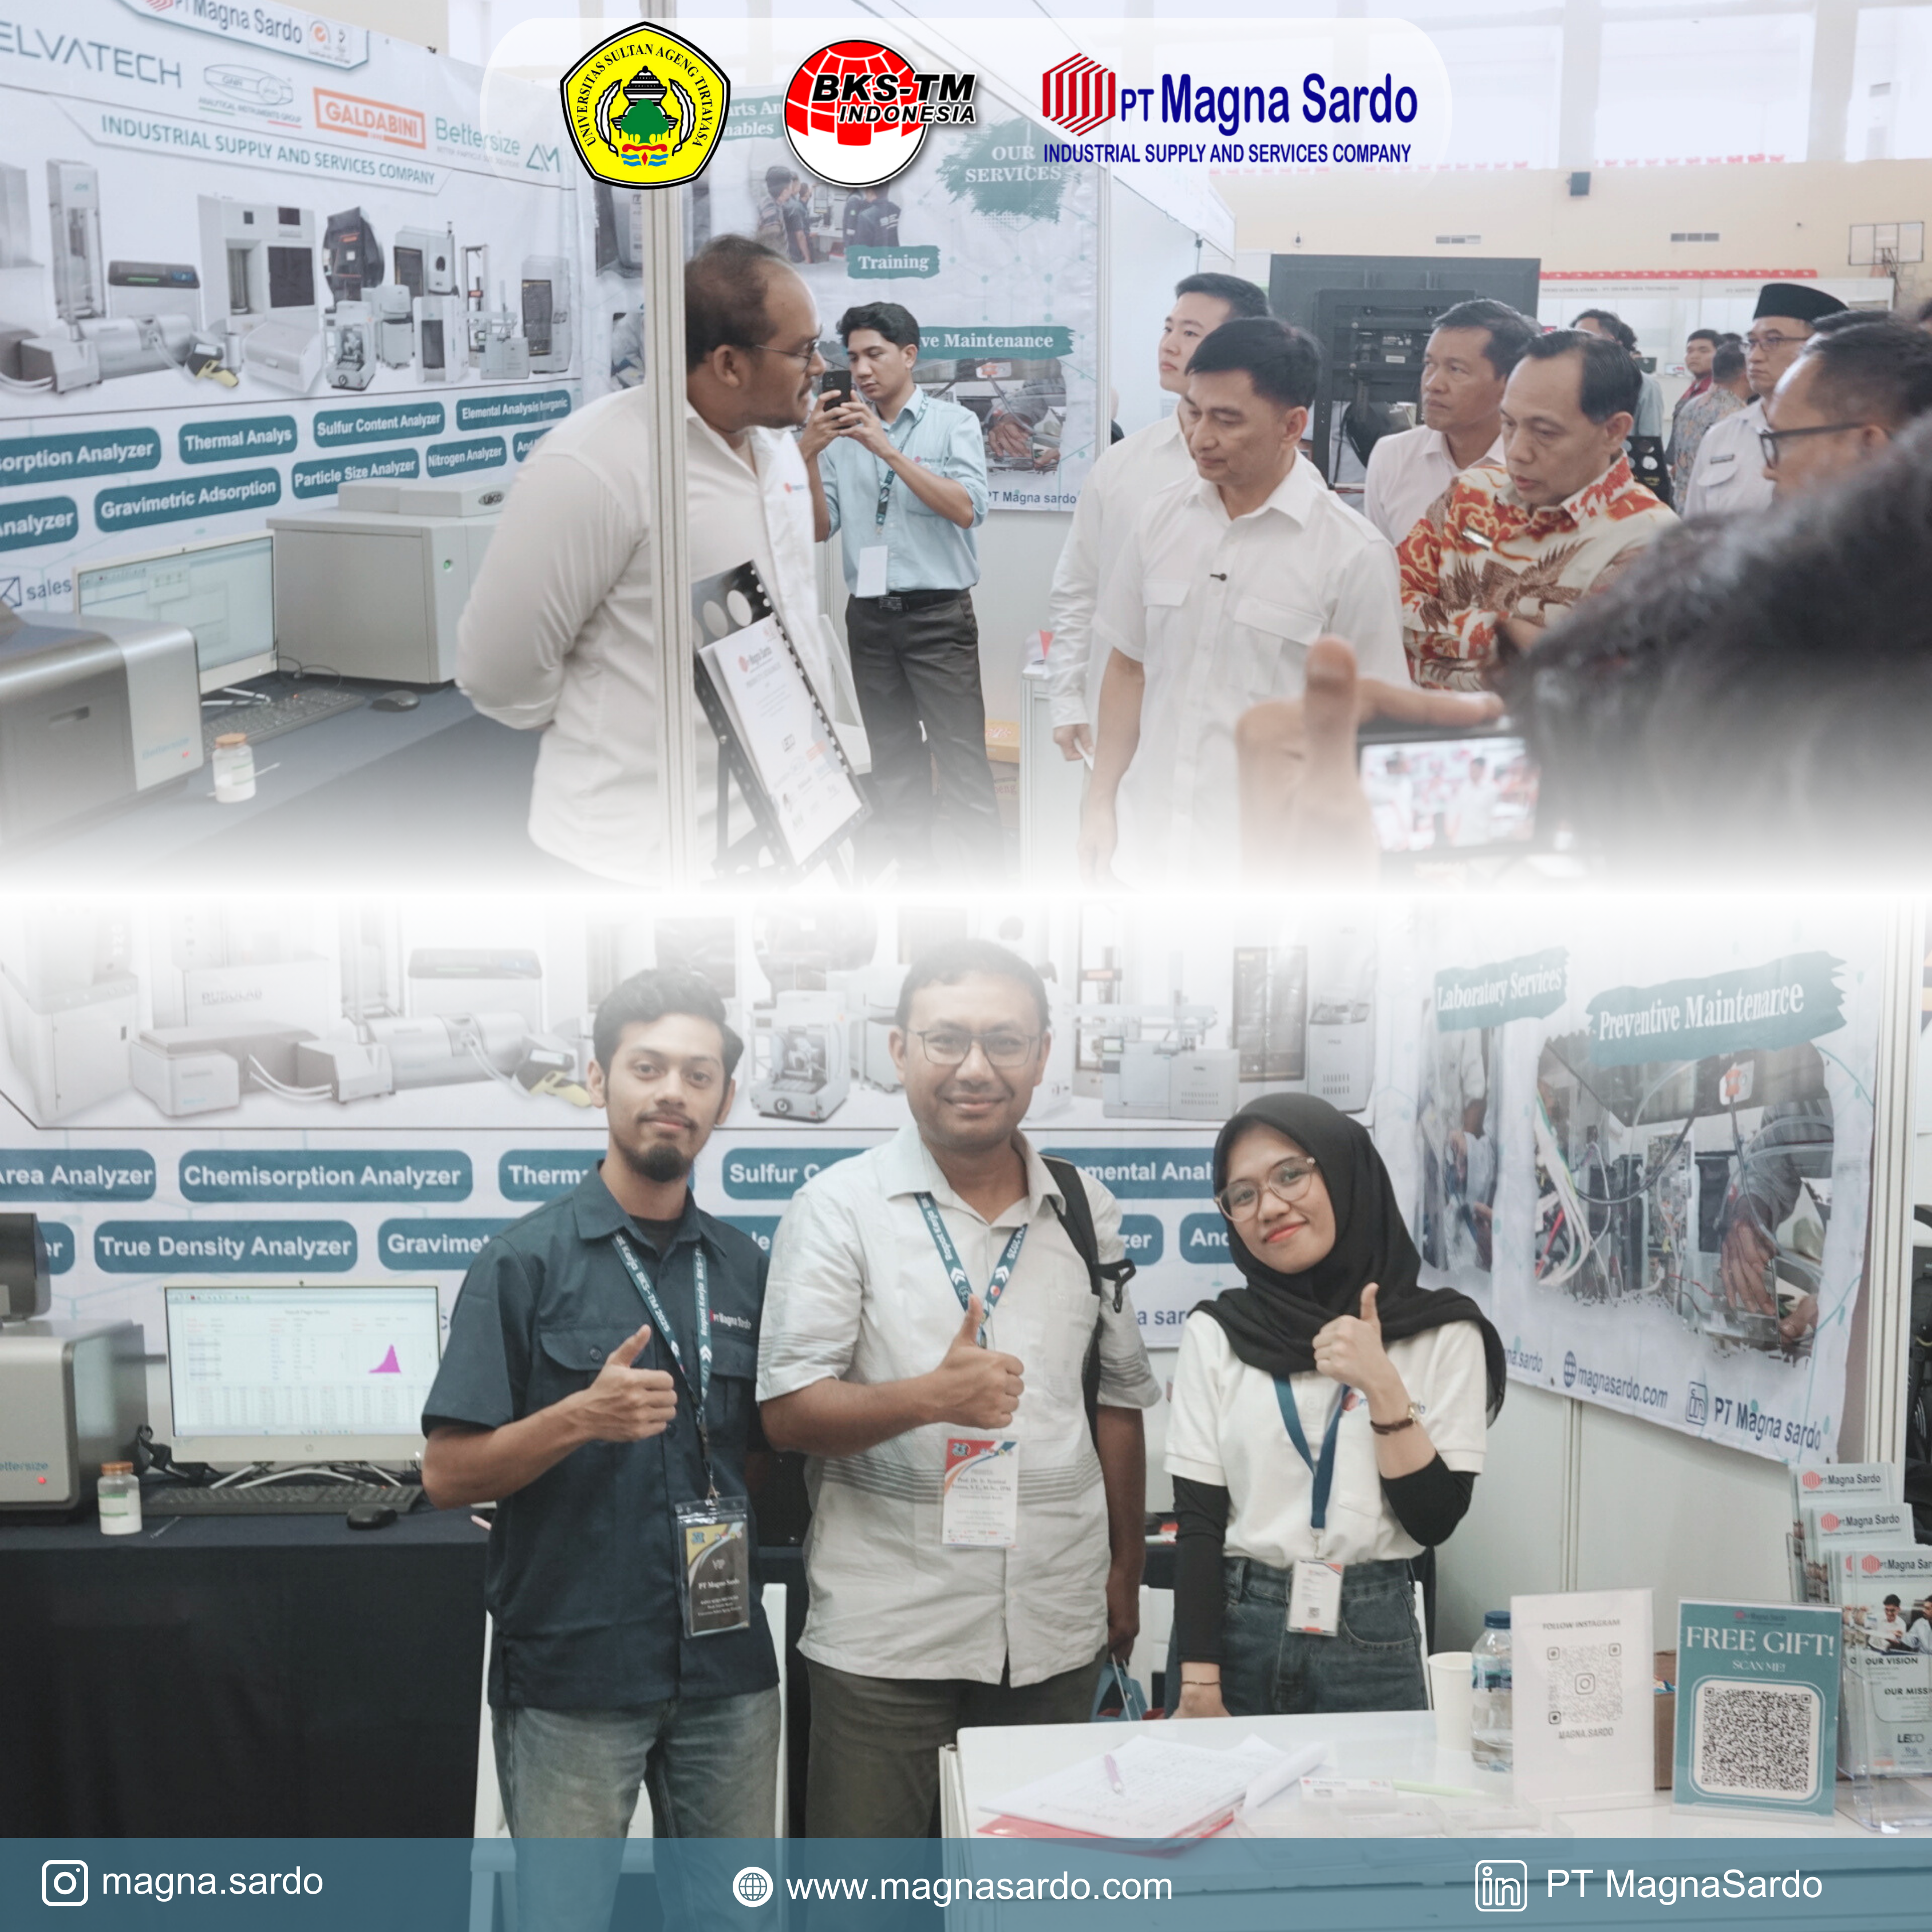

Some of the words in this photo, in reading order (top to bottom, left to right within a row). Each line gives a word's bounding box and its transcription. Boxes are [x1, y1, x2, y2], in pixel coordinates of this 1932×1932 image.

[194, 0, 250, 30] Magna
[254, 9, 302, 44] Sardo
[728, 101, 757, 116] arts
[760, 100, 783, 116] An
[325, 101, 418, 139] GALDABINI
[435, 116, 521, 156] Bettersize
[101, 114, 211, 150] INDUSTRIAL
[215, 135, 272, 159] SUPPLY
[277, 145, 311, 165] AND
[314, 151, 376, 175] SERVICES
[379, 163, 435, 186] COMPANY
[991, 145, 1036, 161] OUR
[965, 165, 1062, 183] SERVICES
[858, 254, 930, 272] Training
[943, 333, 1054, 349] Maintenance
[462, 405, 501, 420] Elemental
[503, 401, 539, 416] Analysis
[317, 418, 354, 437] Sulfur
[355, 416, 398, 433] Content
[400, 413, 441, 429] Analyzer
[184, 431, 244, 452] Thermal
[247, 426, 293, 446] Analys
[0, 447, 73, 474] orption
[77, 443, 154, 464] Analyzer
[428, 453, 465, 468] Nitrogen
[467, 447, 503, 462] Analyzer
[295, 467, 342, 488] Particle
[345, 463, 368, 481] Size
[370, 461, 416, 479] Analyzer
[101, 490, 195, 520] Gravimetric
[198, 480, 276, 505] Adsorption
[1002, 491, 1041, 505] Magna
[1044, 491, 1077, 504] sardo
[26, 579, 73, 601] sales
[1436, 978, 1508, 1013] Laboratory
[1510, 967, 1562, 998] Services
[1598, 998, 1680, 1042] Preventive
[1685, 981, 1804, 1030] Maintenance
[50, 1165, 154, 1190] Analyzer
[184, 1165, 355, 1190] Chemisorption
[359, 1165, 461, 1191] Analyzer
[729, 1163, 799, 1184] Sulfur
[1161, 1161, 1213, 1181] Anal
[100, 1236, 153, 1257] True
[159, 1235, 245, 1261] Density
[251, 1235, 353, 1261] Analyzer
[694, 1247, 704, 1280] BKS-T
[635, 1271, 659, 1310] BKS-TM
[1154, 1309, 1192, 1326] sar
[1504, 1350, 1543, 1373] na.sardo
[1577, 1366, 1669, 1409] magnasardo.com
[1714, 1397, 1733, 1425] PT
[1736, 1404, 1783, 1439] Magna
[1783, 1420, 1822, 1452] sardo
[1828, 1475, 1855, 1487] Magna
[1856, 1473, 1882, 1484] Sardo
[1845, 1516, 1873, 1528] Magna
[1875, 1513, 1901, 1524] Sardo
[1887, 1558, 1915, 1571] Magna
[1917, 1558, 1932, 1569] Sar
[1542, 1622, 1573, 1630] FOLLOW
[1575, 1619, 1621, 1628] INSTAGRAM
[1686, 1626, 1757, 1652] FREE
[1763, 1630, 1835, 1657] GIFT!
[1732, 1660, 1764, 1671] SCAN
[1886, 1657, 1918, 1665] VISION
[1558, 1726, 1614, 1740] MAGNA.SARDO
